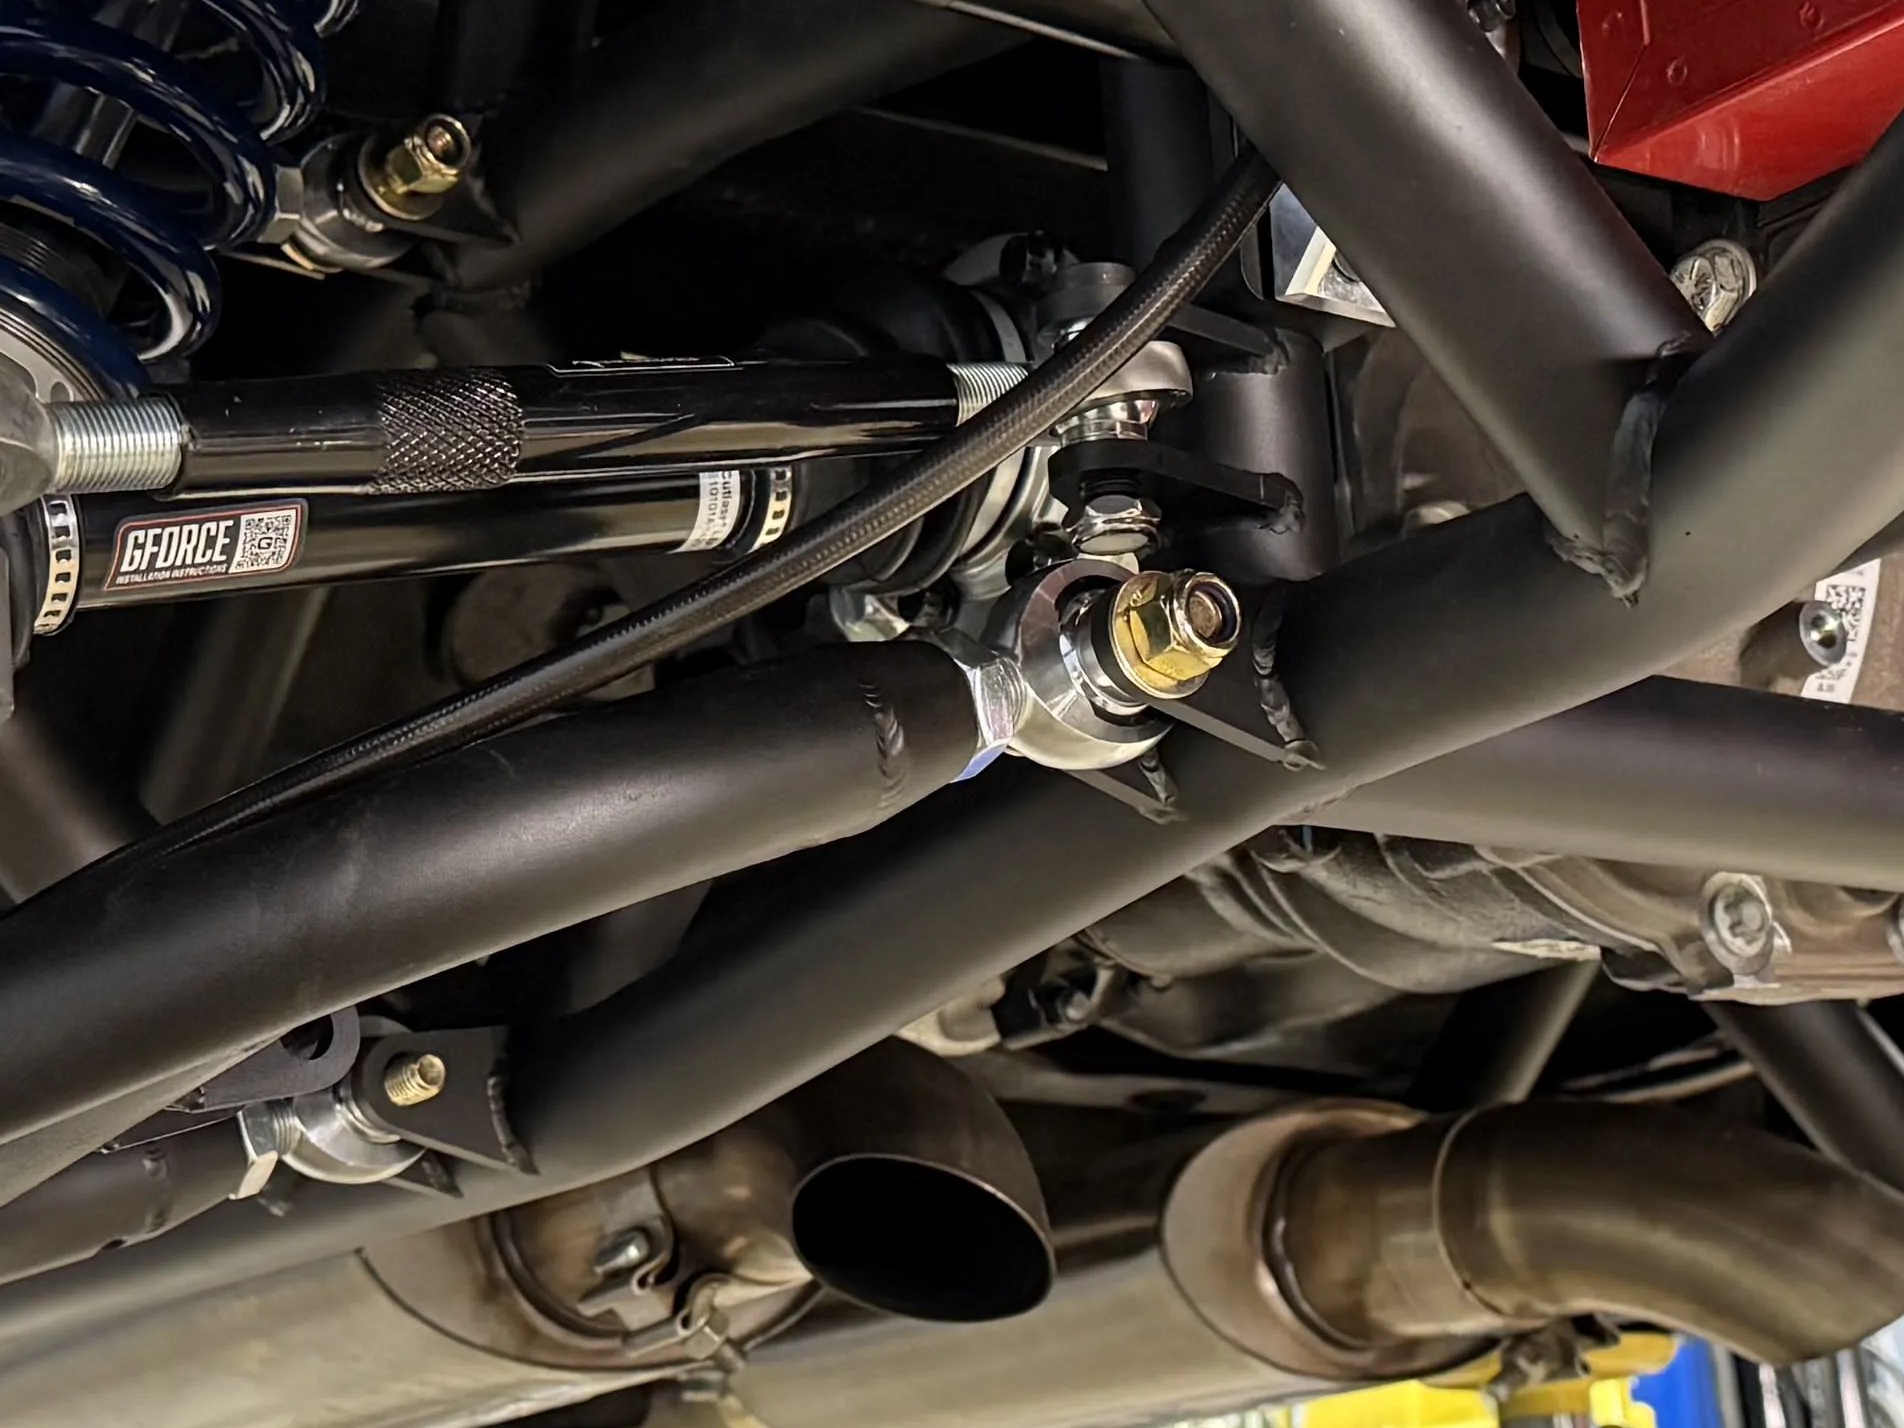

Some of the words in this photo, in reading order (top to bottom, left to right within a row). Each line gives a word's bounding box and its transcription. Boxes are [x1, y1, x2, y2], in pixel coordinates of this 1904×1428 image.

[119, 519, 235, 573] GFORCE
[115, 568, 171, 585] INSTALLATION
[171, 563, 229, 581] INSTRUCTIONS
